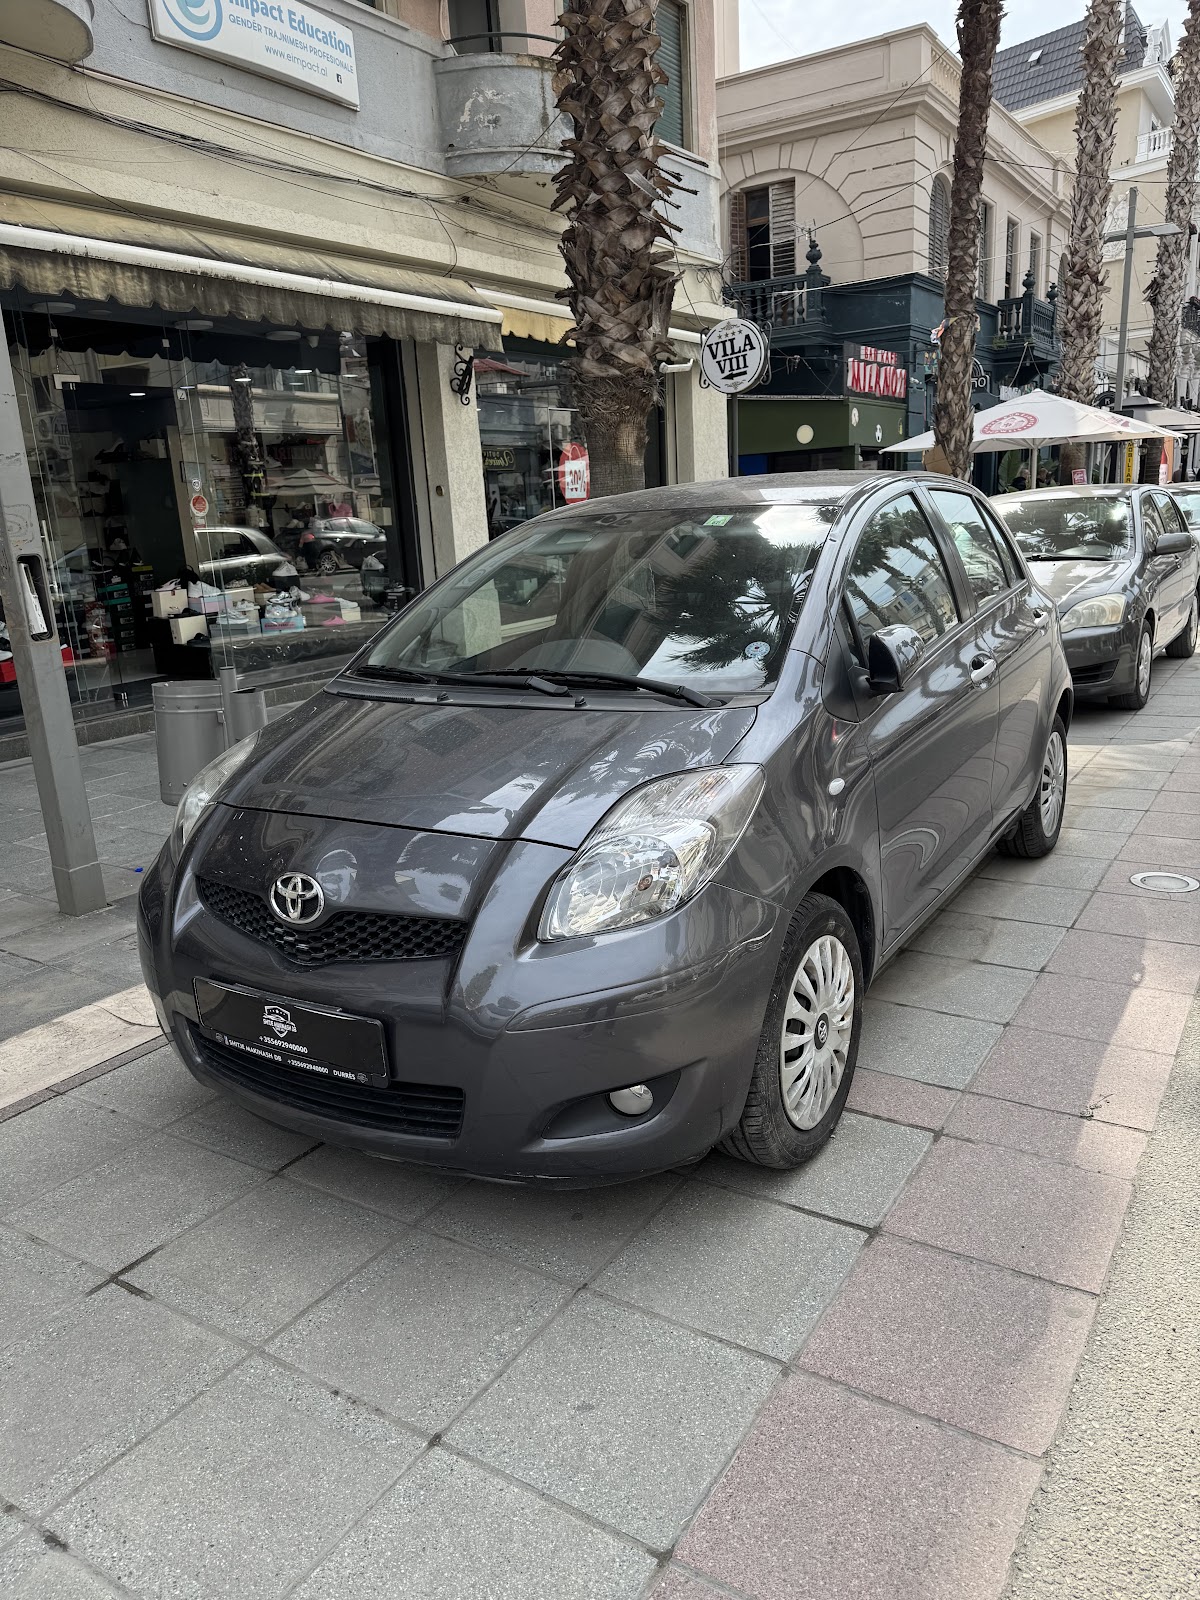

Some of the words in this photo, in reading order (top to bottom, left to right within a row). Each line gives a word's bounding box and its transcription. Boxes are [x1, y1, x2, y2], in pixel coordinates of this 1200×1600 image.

[229, 0, 284, 24] mpact
[288, 9, 352, 58] Education
[264, 26, 308, 52] TRAJNIMESH
[309, 45, 354, 74] PROFESIONALE
[265, 45, 328, 77] www.eimpact.al
[706, 333, 756, 361] VILA
[716, 354, 749, 374] VIII
[259, 1035, 308, 1054] +355692940000
[273, 1054, 282, 1062] DB
